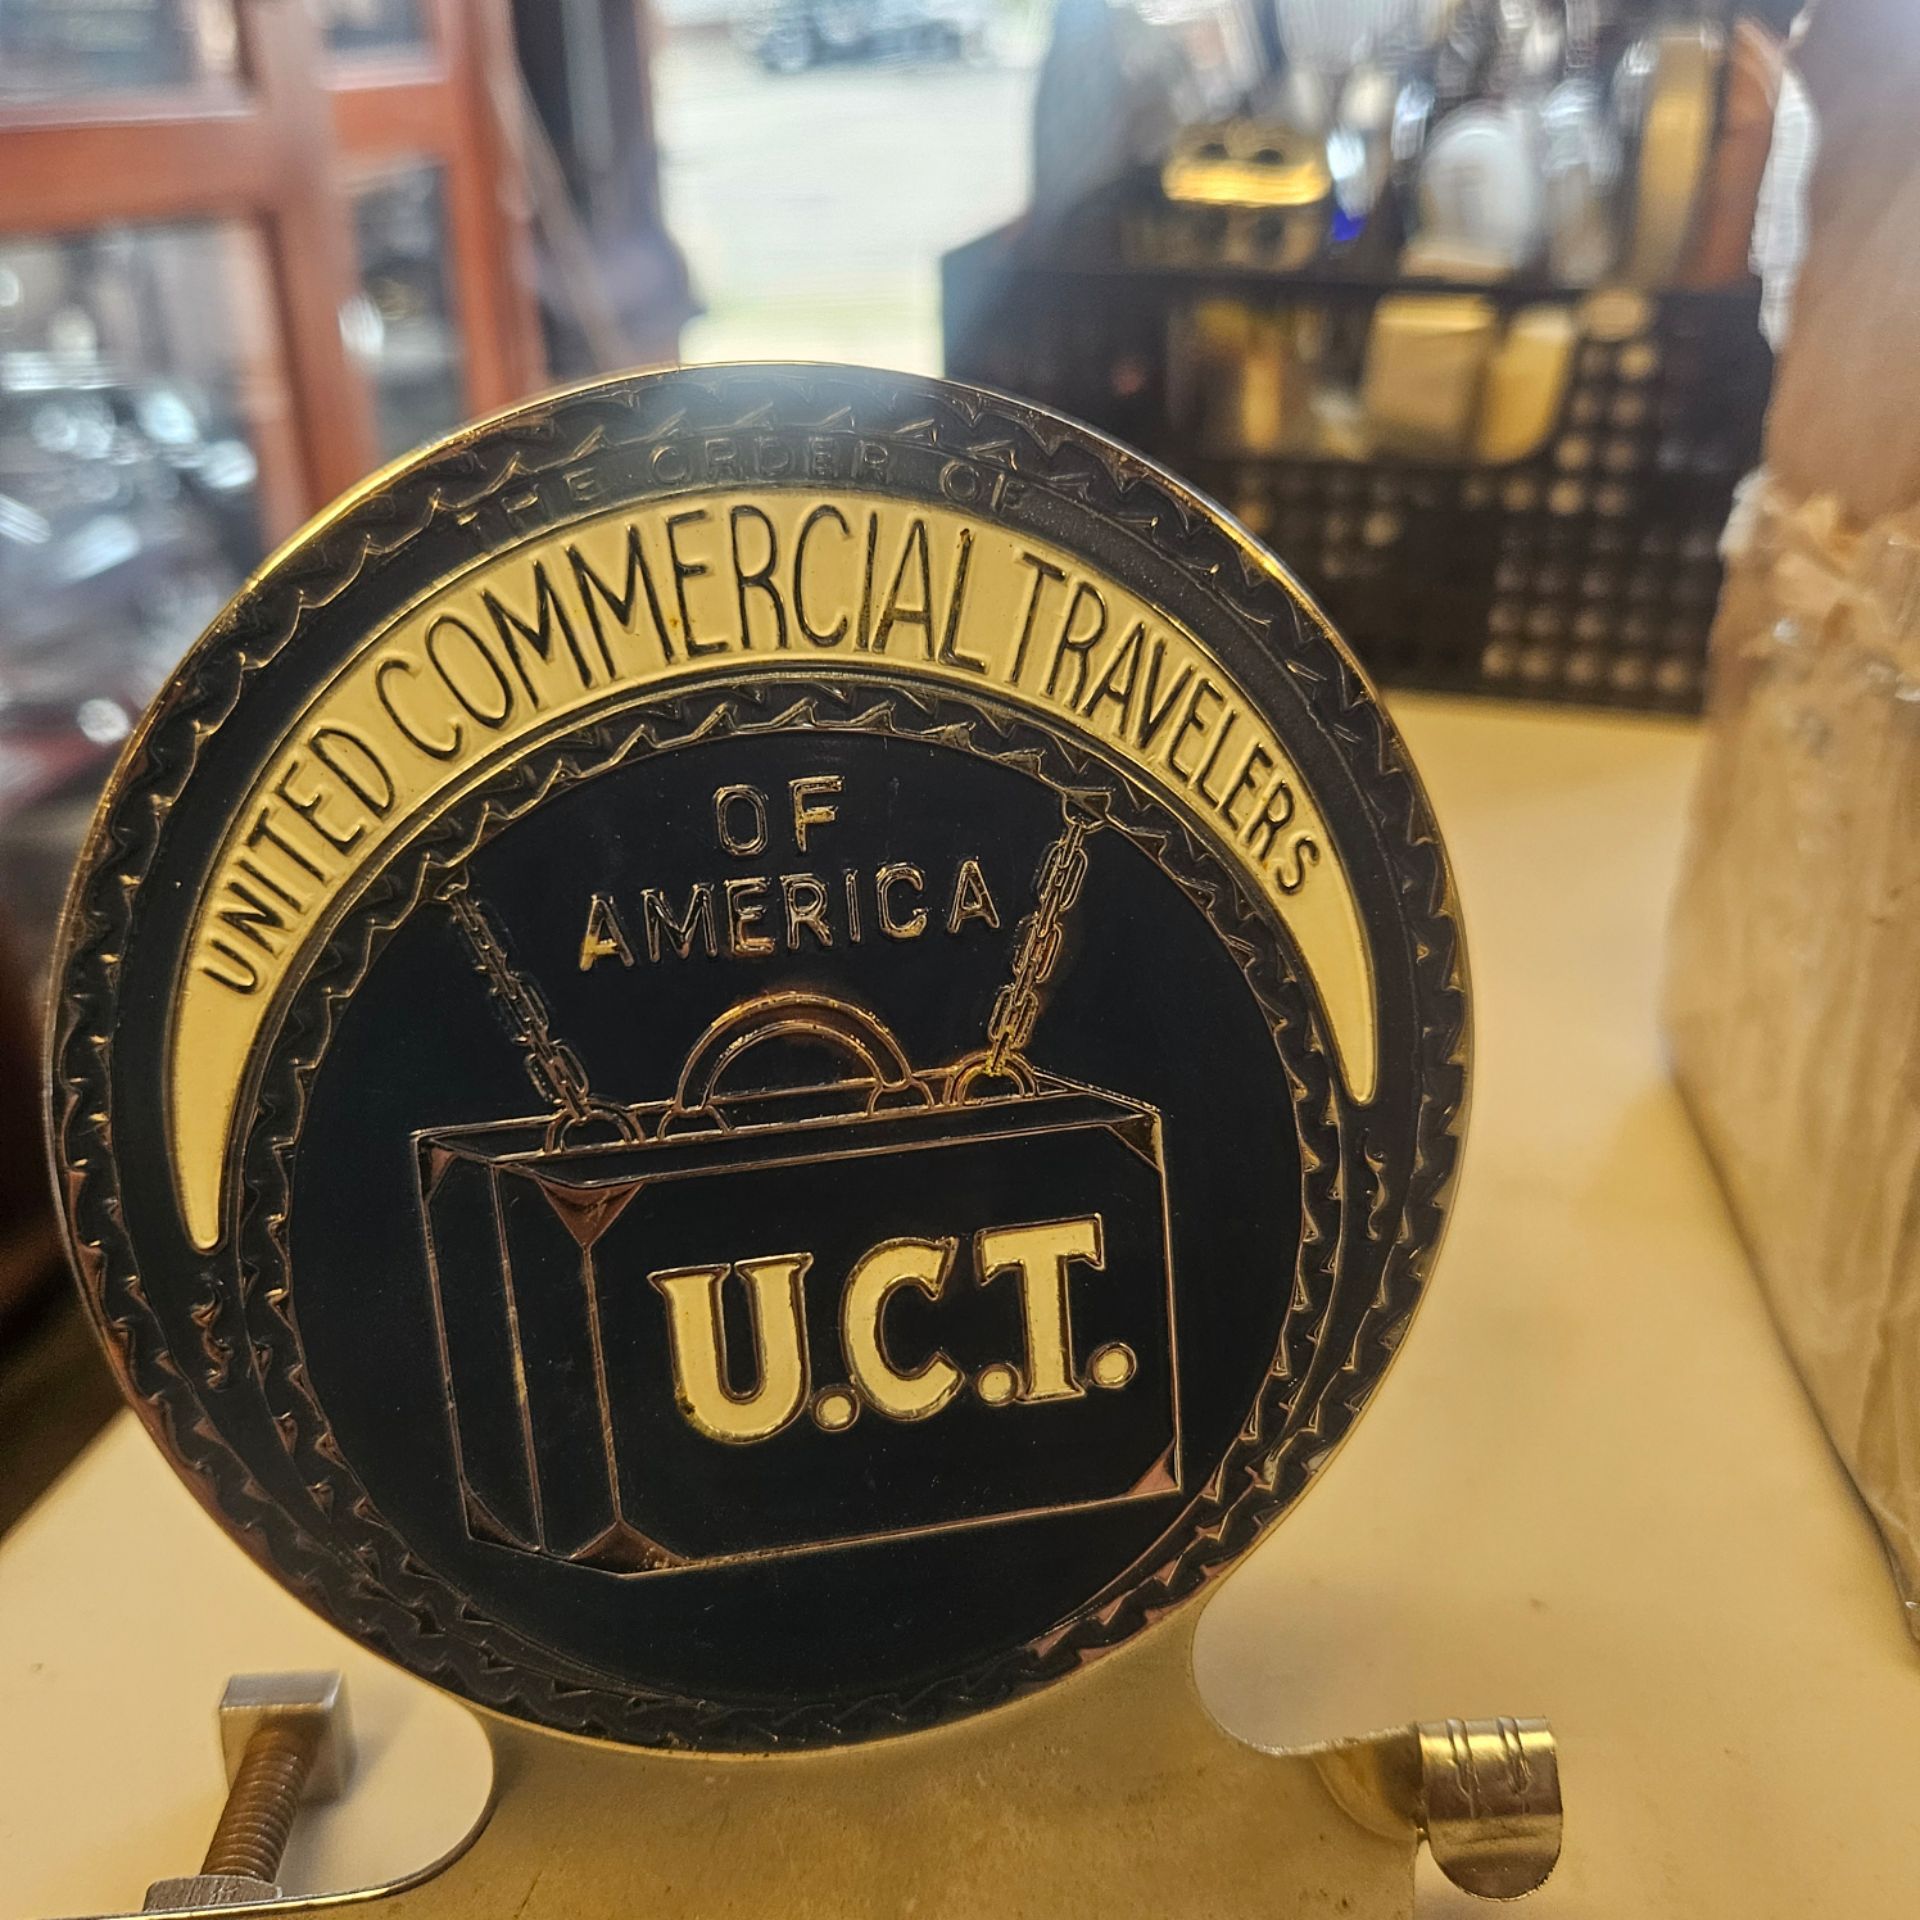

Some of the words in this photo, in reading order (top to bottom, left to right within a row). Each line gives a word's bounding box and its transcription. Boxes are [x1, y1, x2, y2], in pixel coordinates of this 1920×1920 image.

[453, 466, 600, 537] THE
[650, 436, 894, 486] ORDER
[938, 459, 1028, 513] OF
[200, 725, 397, 996] UNITED
[375, 503, 990, 761] COMMERCIAL
[1008, 550, 1320, 892] TRAVELERS
[711, 774, 845, 857] OF
[579, 854, 1001, 972] AMERICA
[647, 1212, 1137, 1445] U.C.T.
